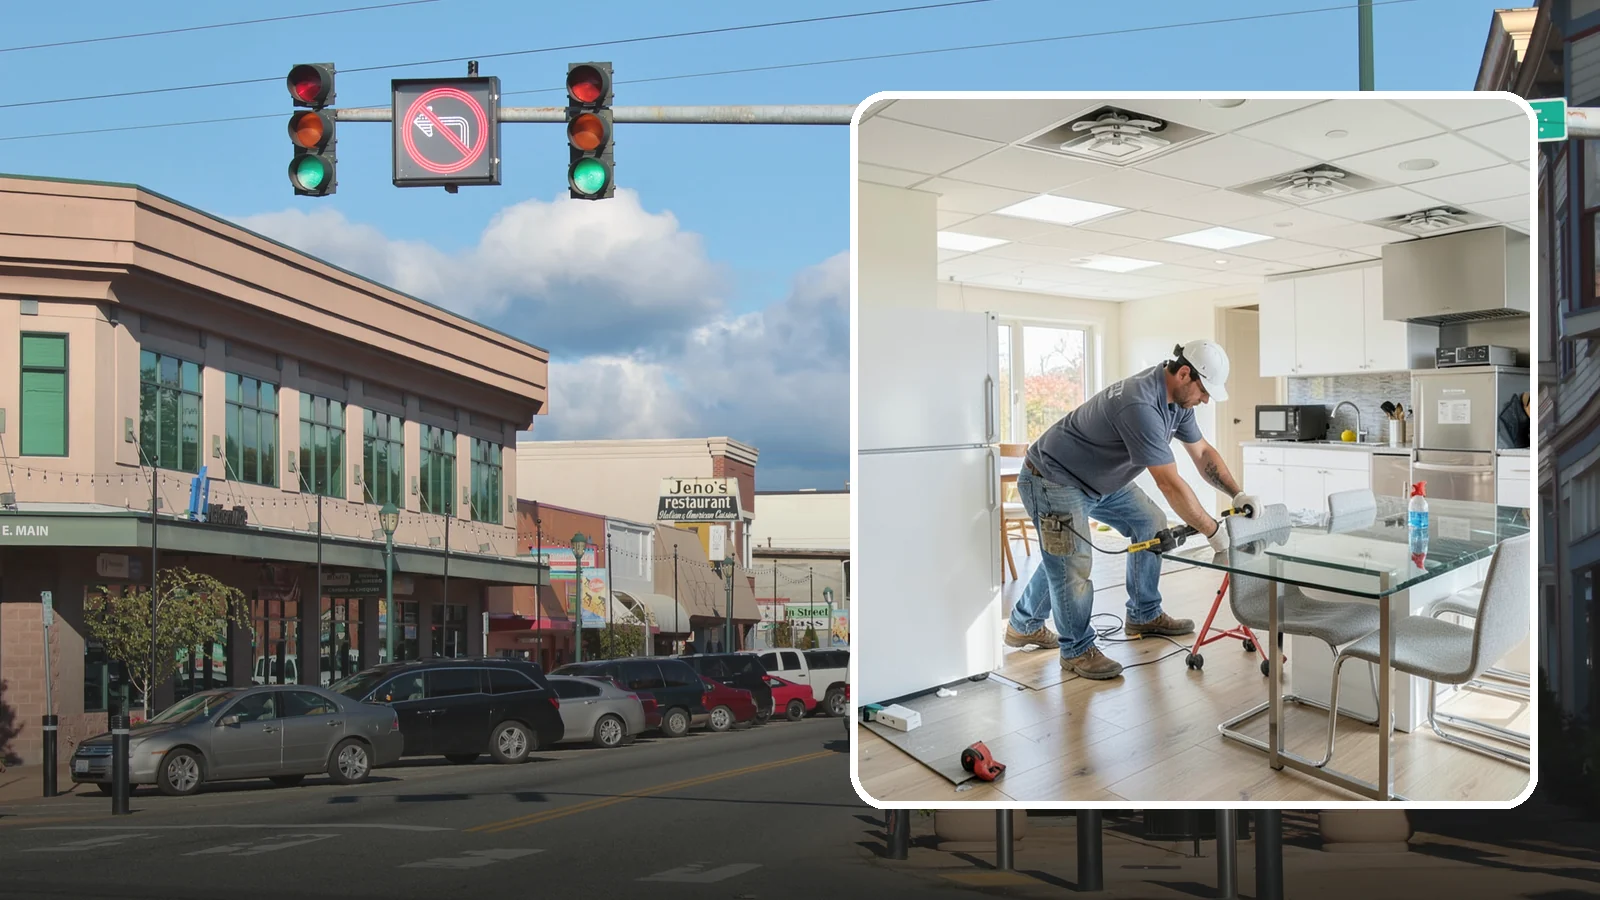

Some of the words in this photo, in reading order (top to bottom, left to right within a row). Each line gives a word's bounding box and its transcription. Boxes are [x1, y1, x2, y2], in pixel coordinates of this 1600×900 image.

[670, 479, 728, 494] Jeno's
[665, 496, 731, 508] restaurant
[686, 510, 714, 519] American
[715, 509, 738, 519] Cuisine
[2, 525, 13, 536] E.
[15, 525, 49, 536] MAIN
[797, 607, 828, 616] Street
